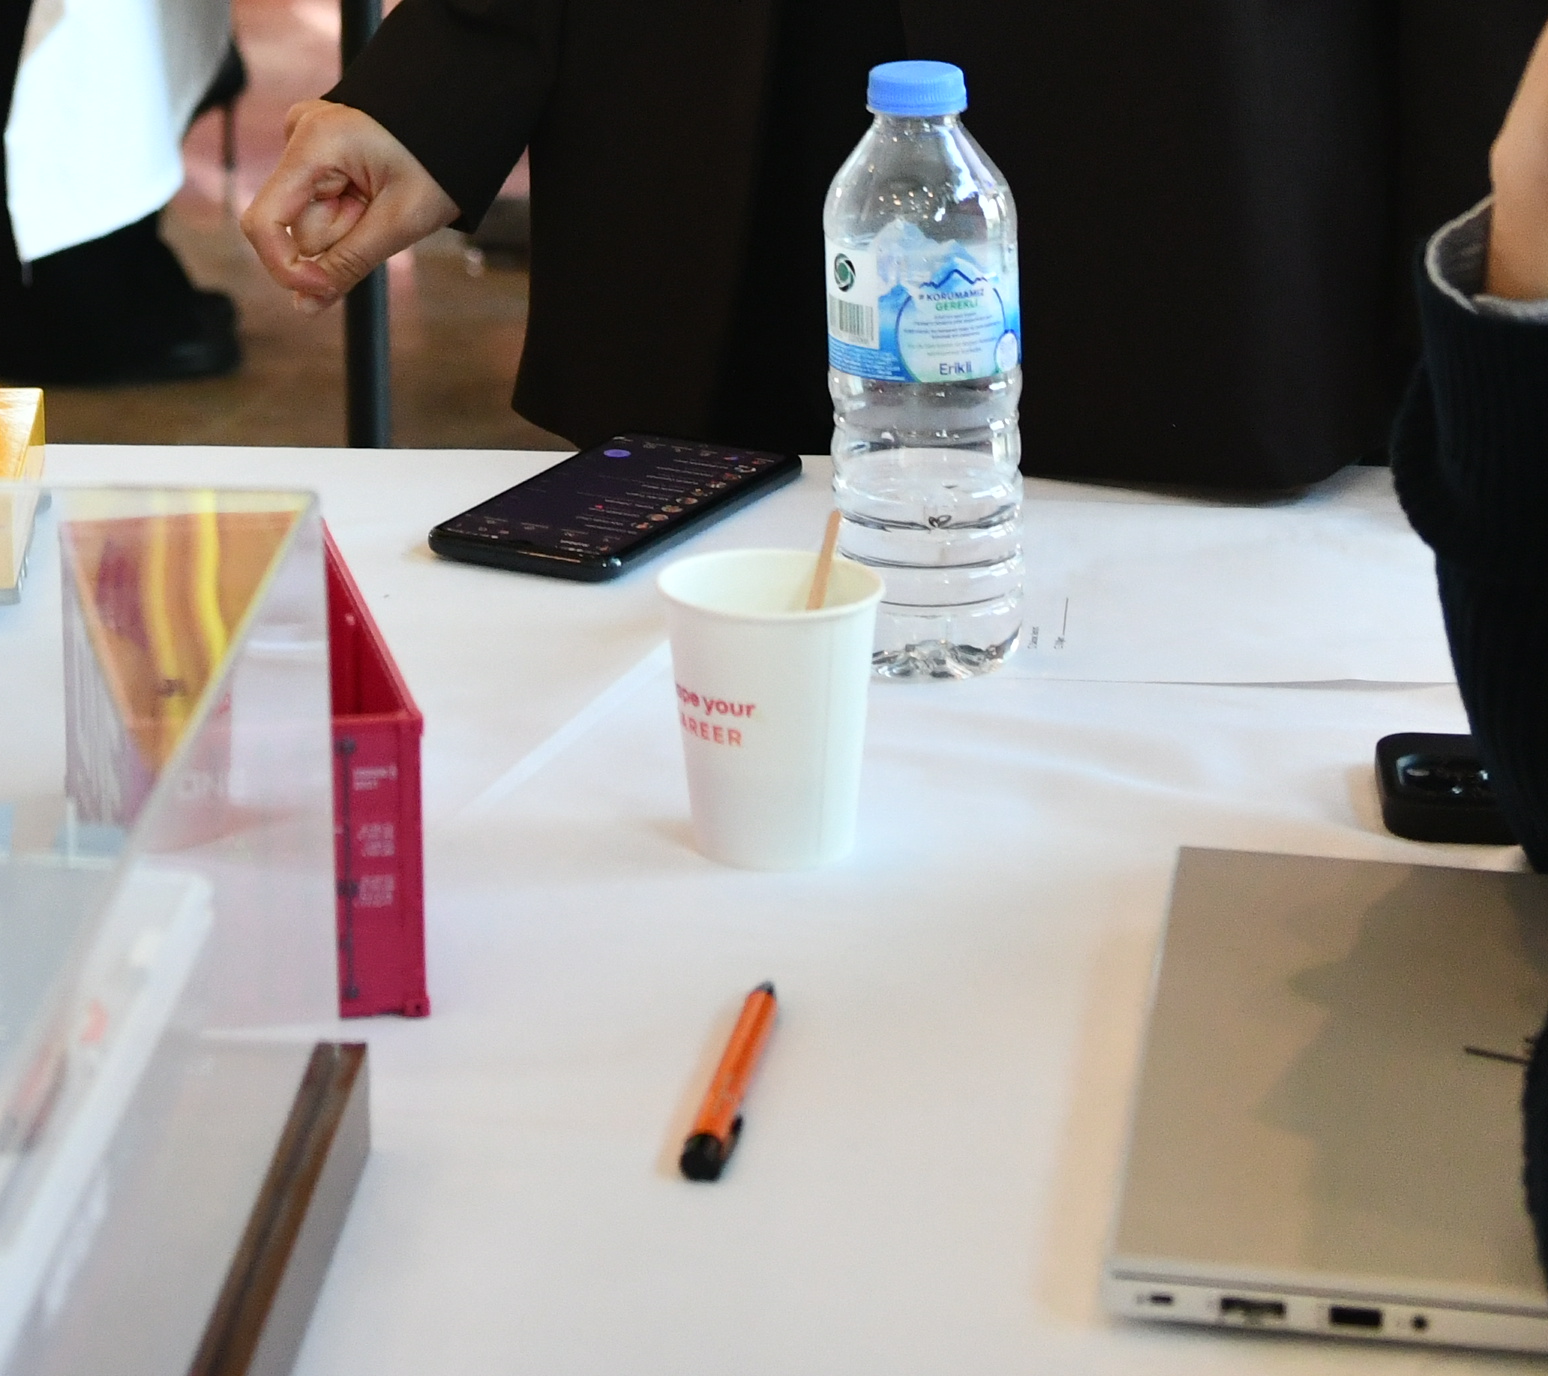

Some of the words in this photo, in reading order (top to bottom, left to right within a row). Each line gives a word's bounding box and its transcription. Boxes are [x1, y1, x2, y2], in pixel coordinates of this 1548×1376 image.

[939, 361, 973, 377] Erikli
[703, 697, 755, 718] your
[681, 713, 741, 746] AREER
